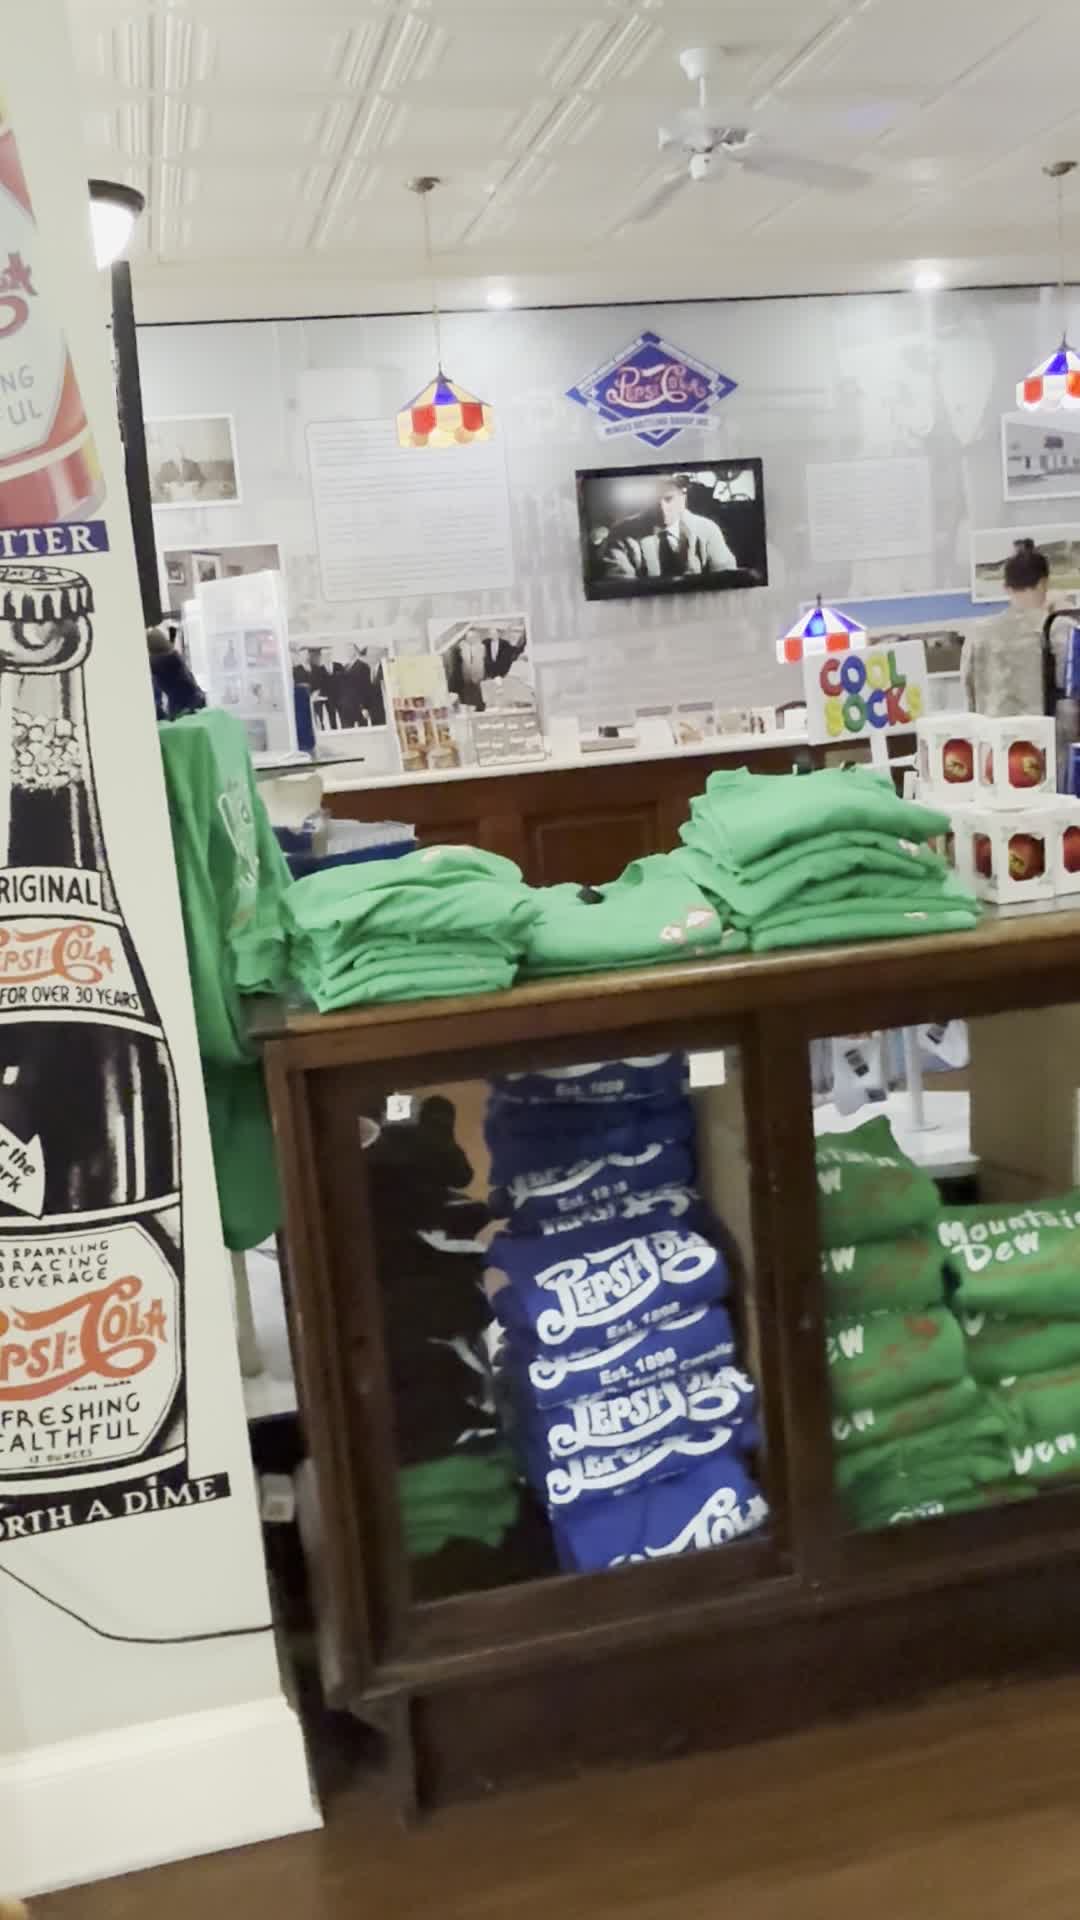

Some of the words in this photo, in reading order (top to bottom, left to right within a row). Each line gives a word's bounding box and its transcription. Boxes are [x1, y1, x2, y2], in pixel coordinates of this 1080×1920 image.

[819, 650, 906, 697] COOL
[824, 685, 923, 737] SOCKS
[0, 986, 27, 1005] FOR
[32, 985, 69, 1004] OVER
[75, 985, 93, 1004] 30
[96, 987, 139, 1011] YEARS
[13, 1239, 109, 1258] SPARKLING
[86, 1498, 113, 1522] A
